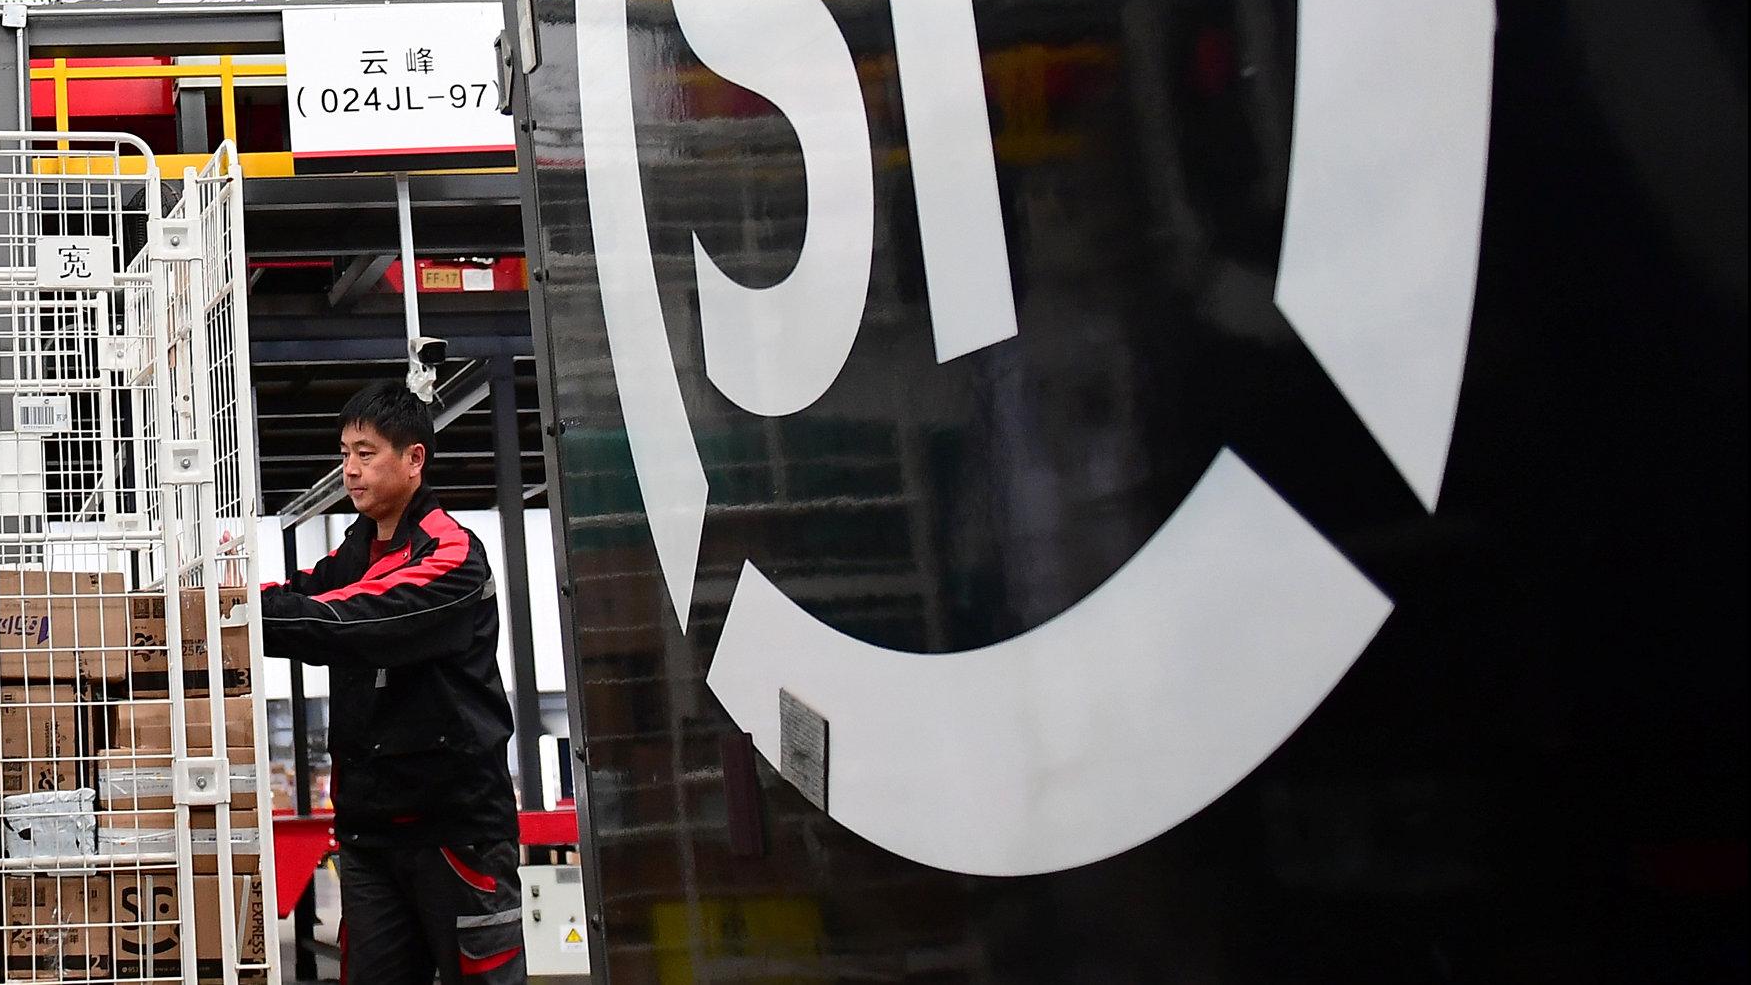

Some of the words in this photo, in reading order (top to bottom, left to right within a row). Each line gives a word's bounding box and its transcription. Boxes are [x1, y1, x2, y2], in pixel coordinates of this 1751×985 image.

[359, 47, 435, 75] 云峰
[58, 244, 92, 279] 宽
[252, 902, 266, 955] EXPRESS
